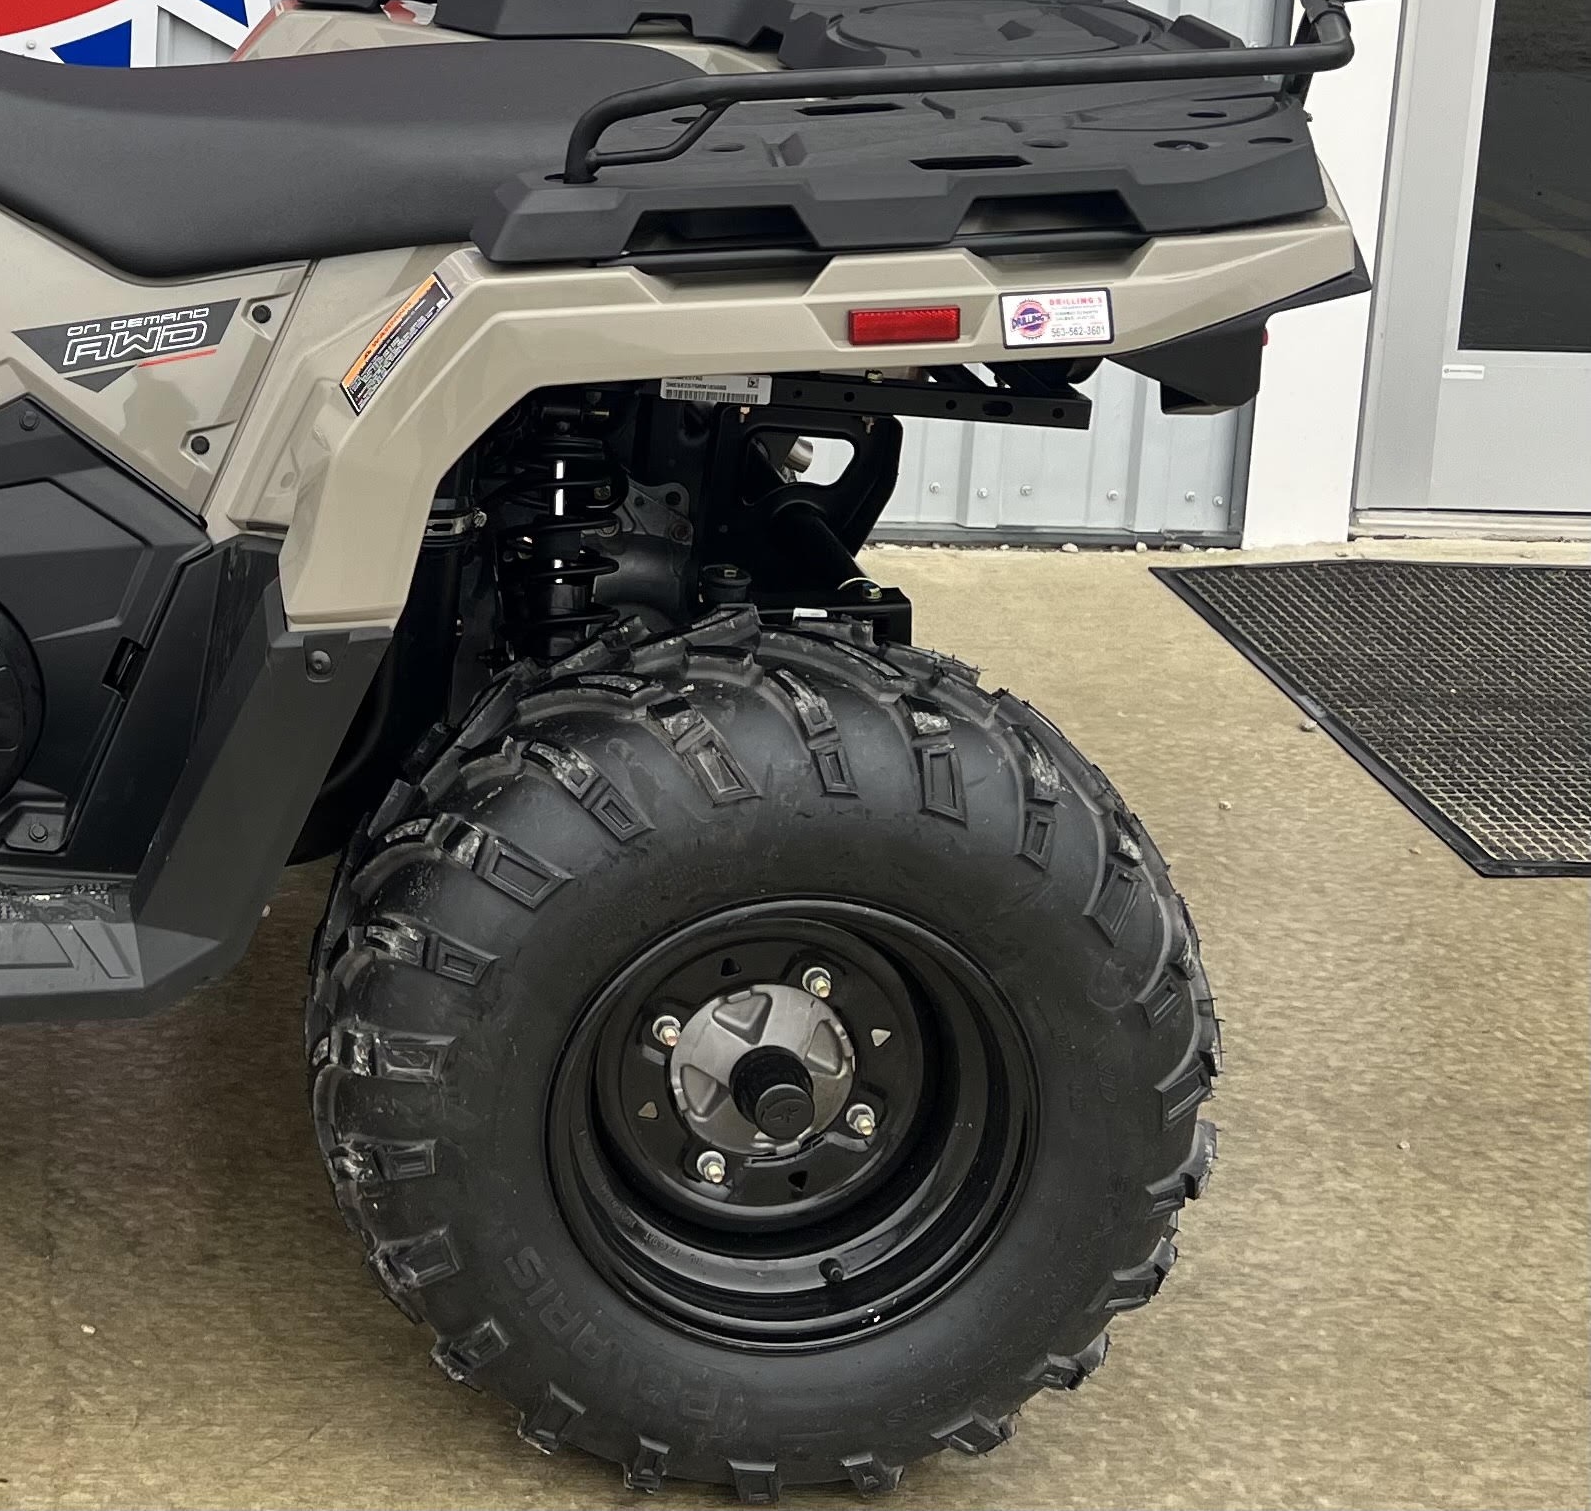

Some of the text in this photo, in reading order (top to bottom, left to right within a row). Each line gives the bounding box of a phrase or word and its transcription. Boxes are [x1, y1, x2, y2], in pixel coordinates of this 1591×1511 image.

[66, 307, 209, 337] ON DEMAND
[63, 320, 208, 366] AWD
